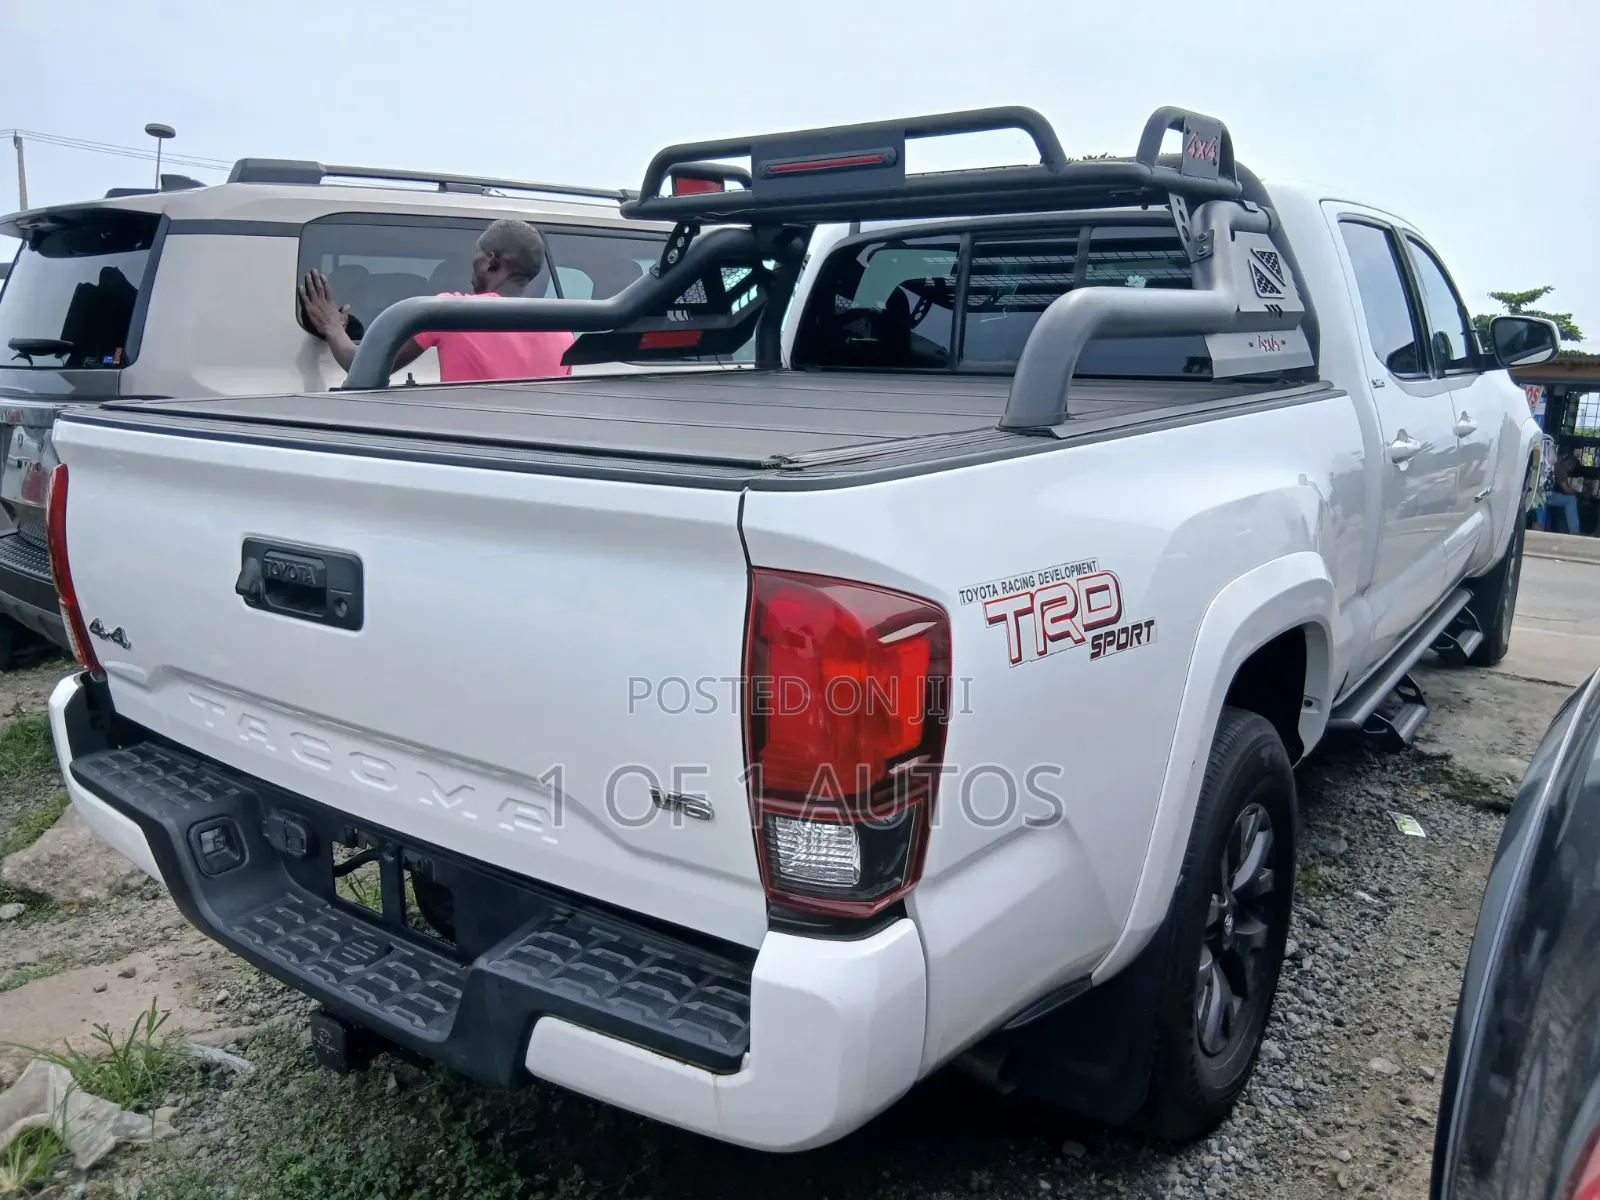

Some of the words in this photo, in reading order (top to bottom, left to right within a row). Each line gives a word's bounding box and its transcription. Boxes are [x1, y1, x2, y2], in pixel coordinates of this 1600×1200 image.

[263, 558, 317, 585] TOYOTA
[959, 585, 999, 604] TOYOTA
[1001, 575, 1036, 594] RACING
[1038, 560, 1098, 586] DEVELOPMENT
[983, 571, 1123, 665] TRD
[1090, 619, 1155, 660] SPORT
[188, 692, 560, 845] TACOMA
[648, 785, 715, 821] V6
